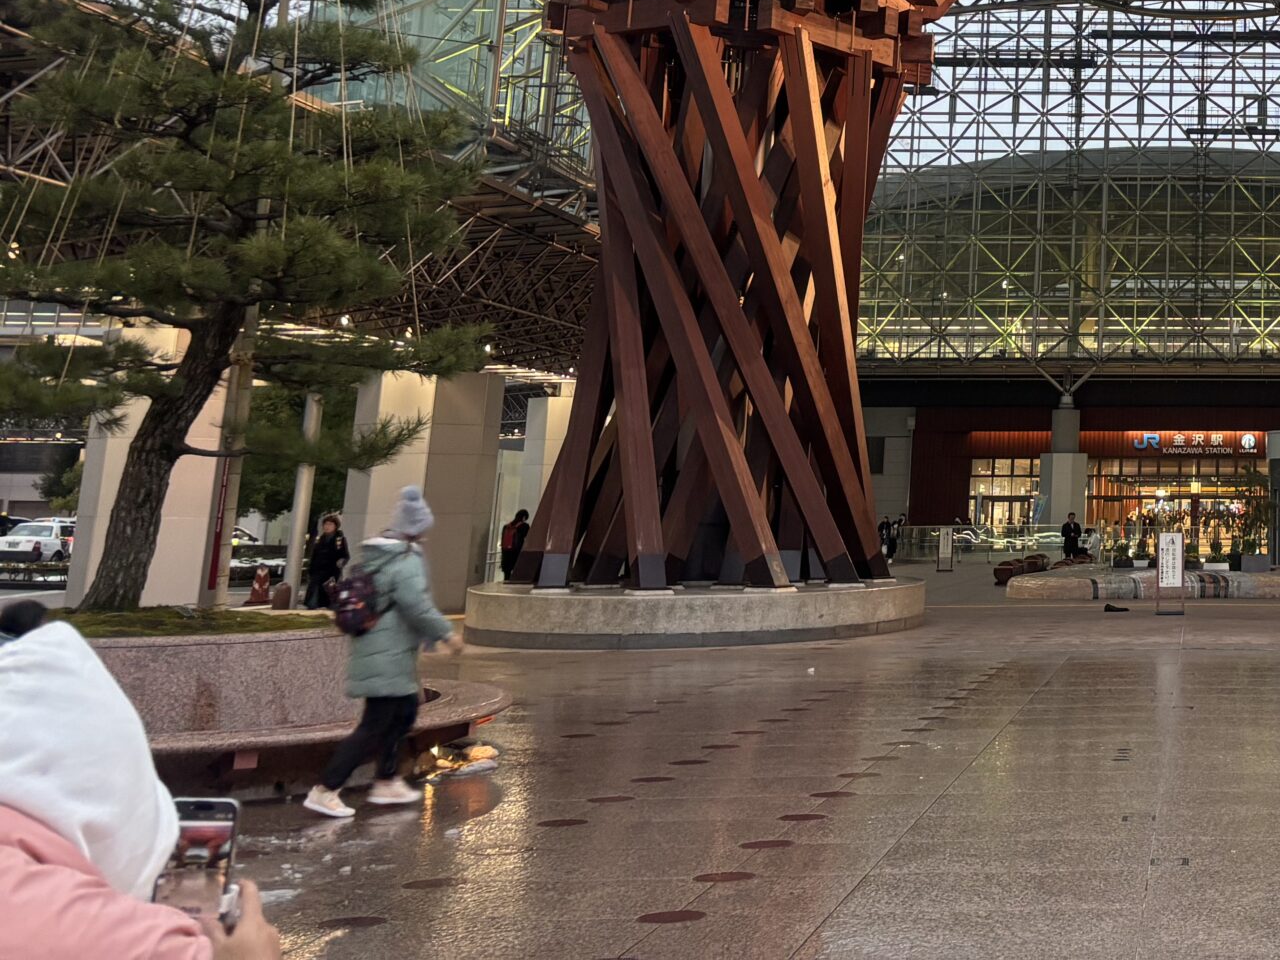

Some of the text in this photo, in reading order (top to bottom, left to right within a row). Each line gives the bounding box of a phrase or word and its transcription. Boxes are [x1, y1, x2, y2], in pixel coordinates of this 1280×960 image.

[1133, 433, 1224, 449] JR 金沢駅
[1205, 447, 1233, 455] STATION
